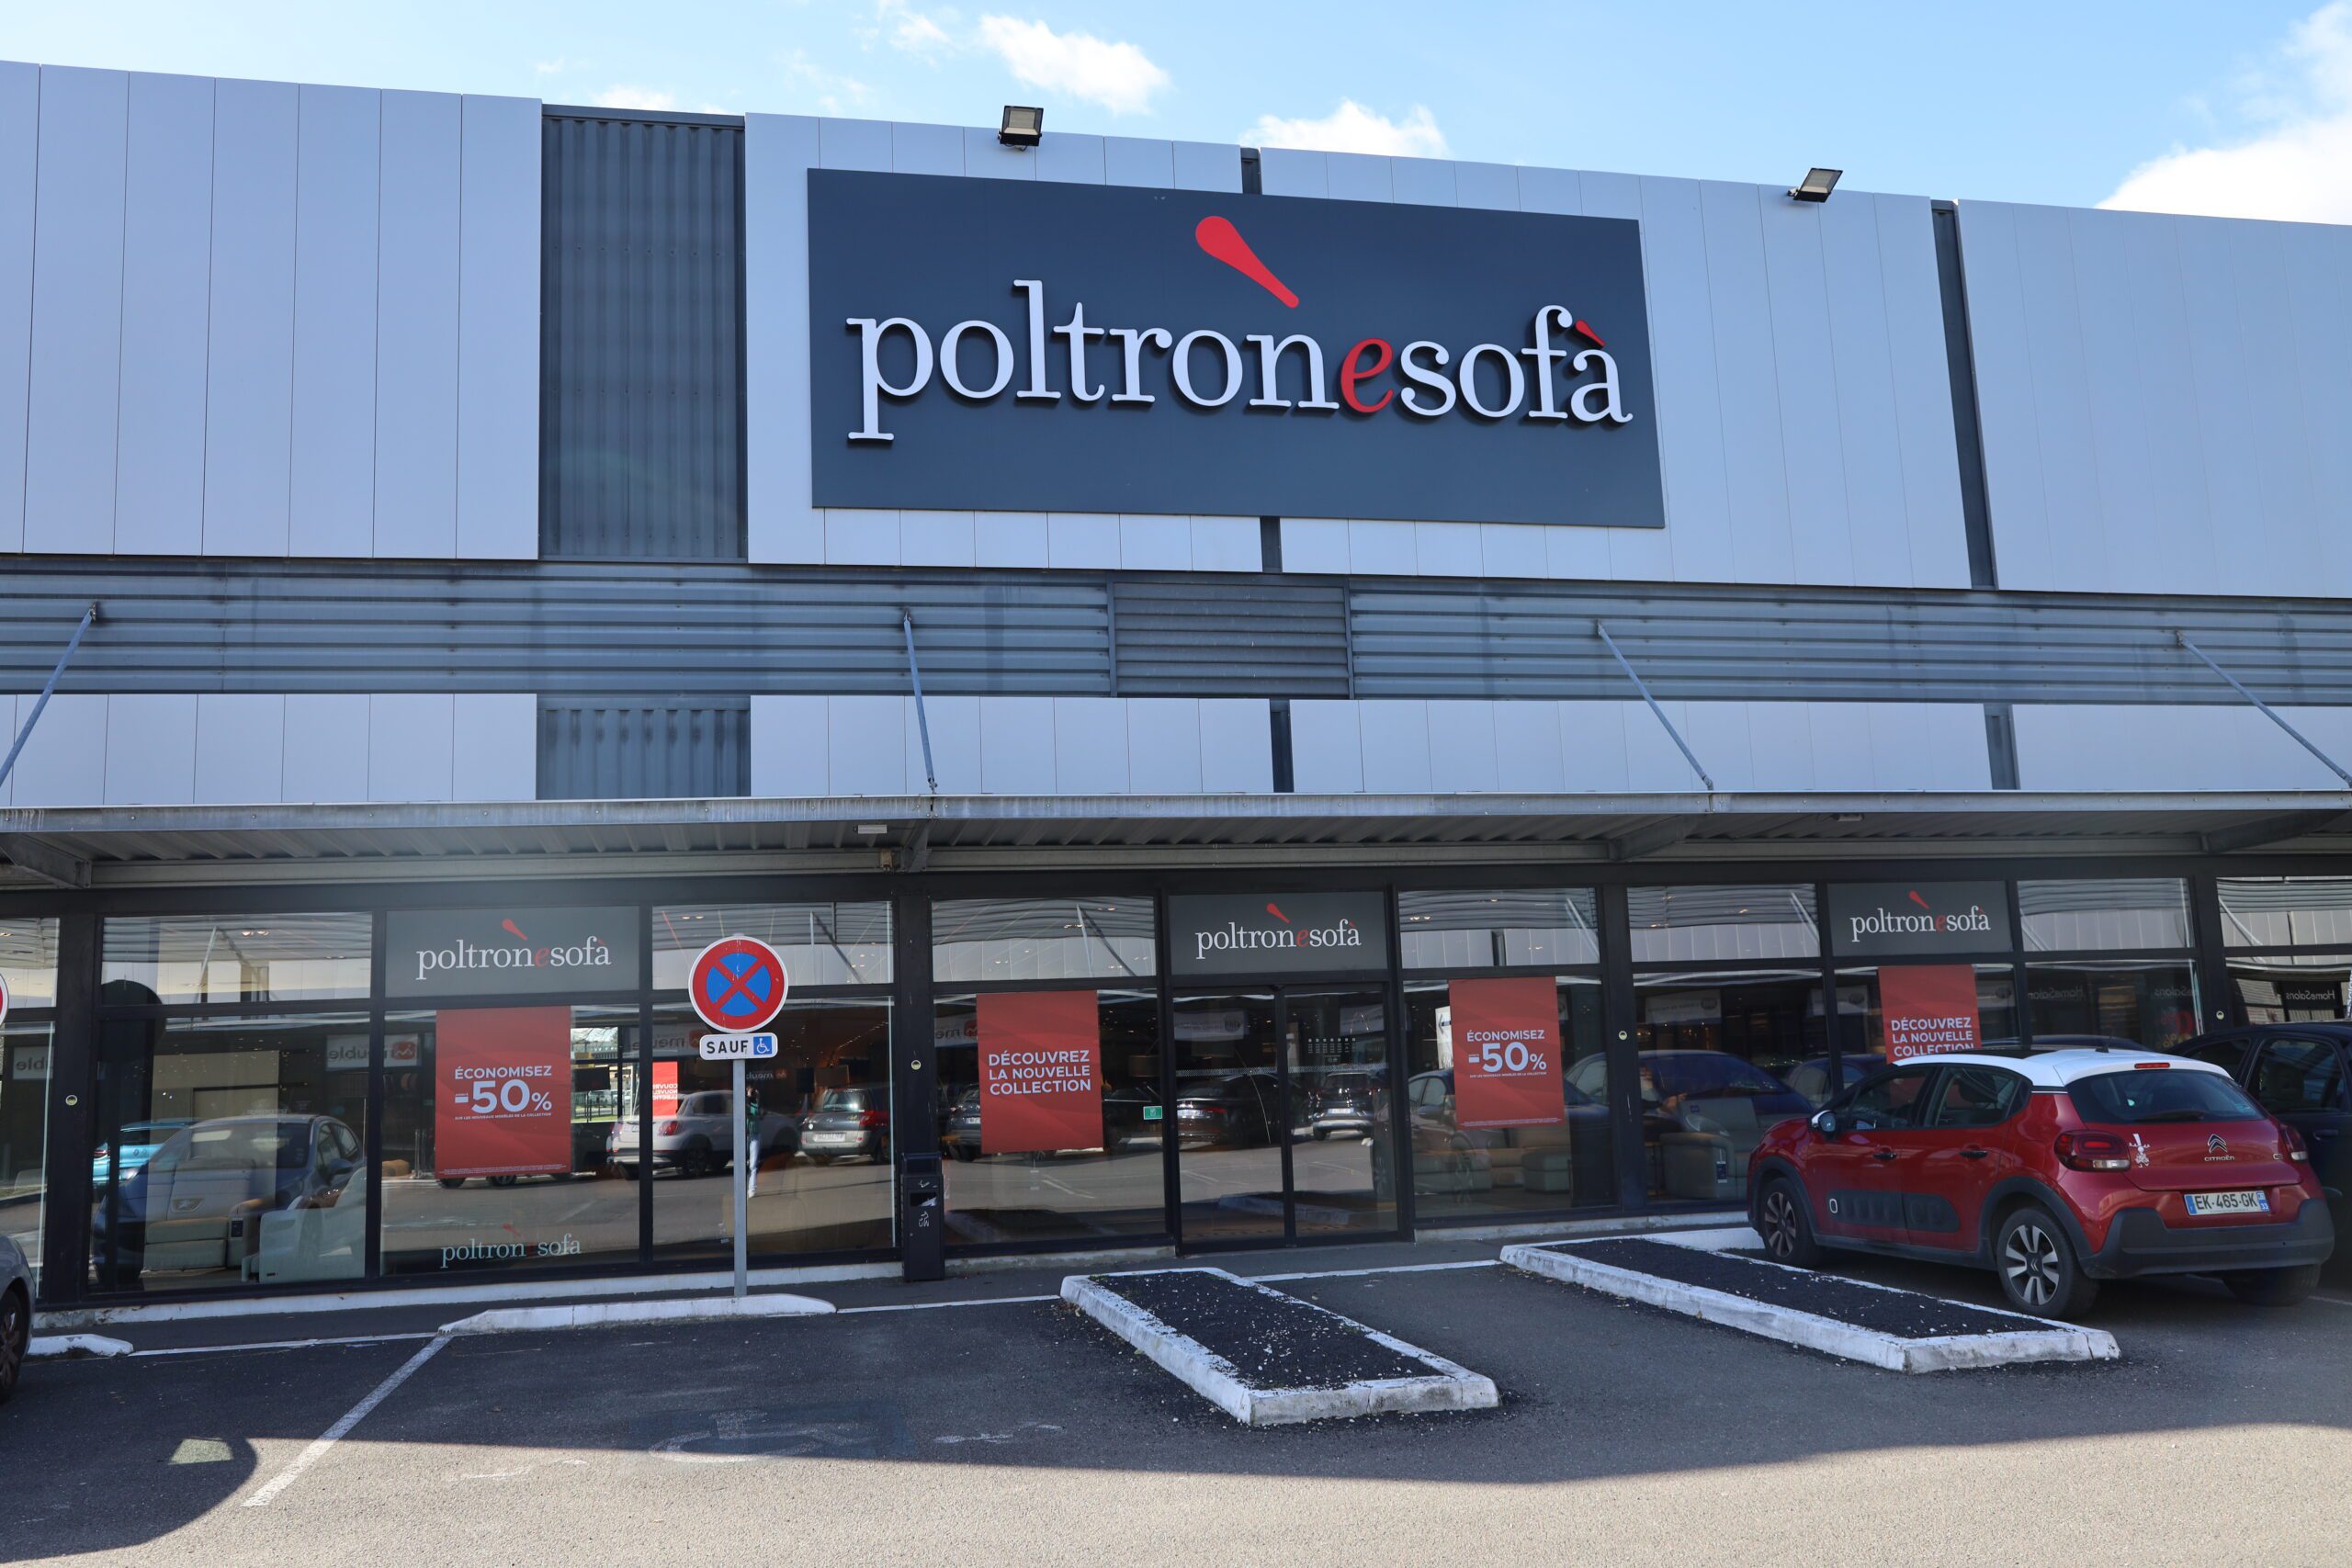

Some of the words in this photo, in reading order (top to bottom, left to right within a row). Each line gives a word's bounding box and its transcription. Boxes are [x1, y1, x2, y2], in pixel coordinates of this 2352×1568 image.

[1891, 1016, 1973, 1031] DÉCOUVREZ
[1466, 1029, 1545, 1043] ÉCONOMISEZ
[1893, 1033, 1908, 1043] LA
[1911, 1031, 1973, 1043] NOUVELLE
[707, 1040, 749, 1055] SAUF
[989, 1050, 1090, 1066] DÉCOUVREZ
[1468, 1042, 1547, 1073] -50%
[455, 1066, 552, 1079] ÉCONOMISEZ
[989, 1068, 1008, 1080] LA
[1012, 1065, 1091, 1079] NOUVELLE
[989, 1078, 1091, 1095] COLLECTION
[455, 1078, 552, 1113] -50%
